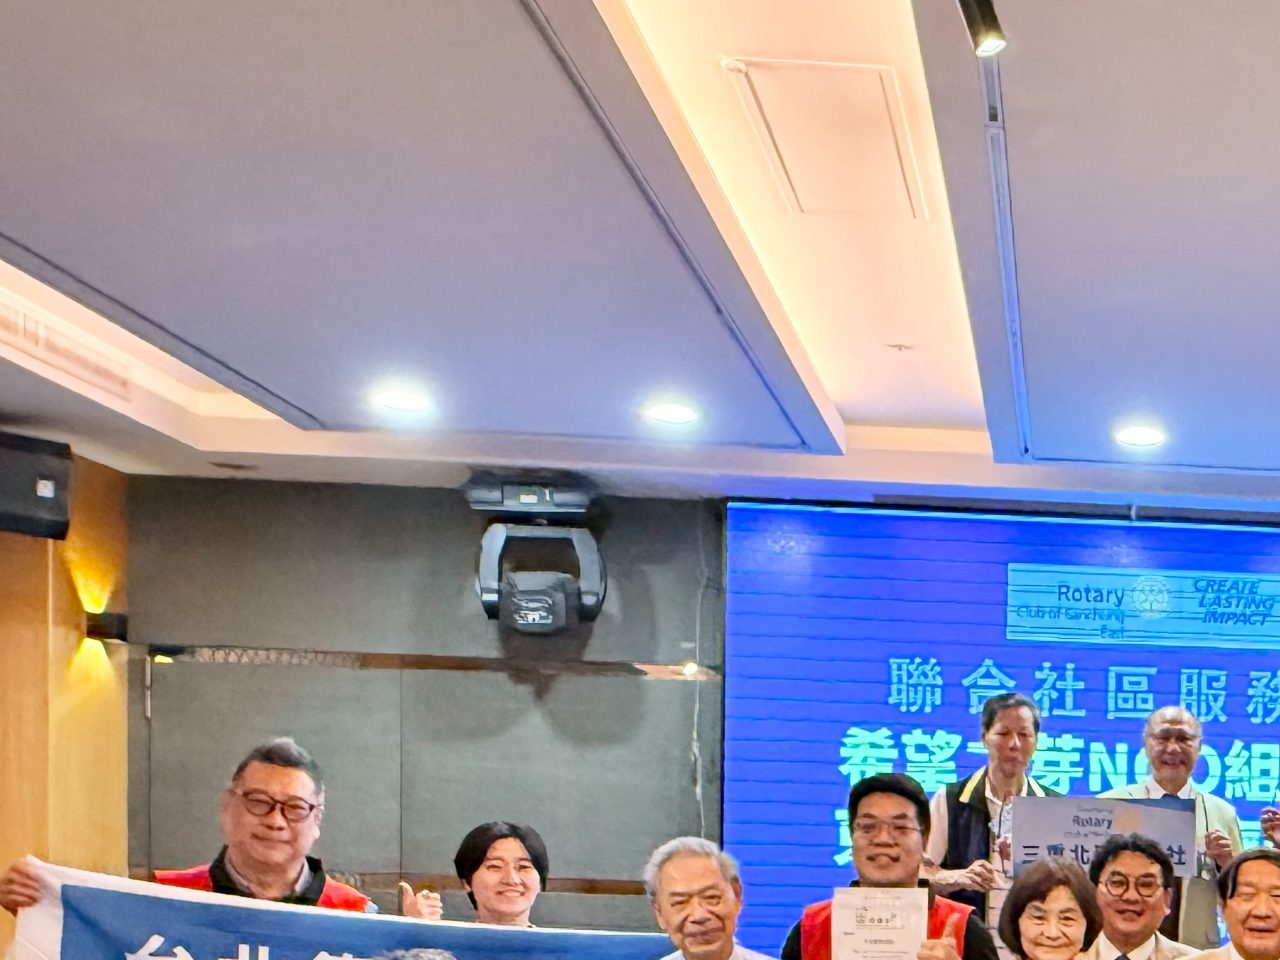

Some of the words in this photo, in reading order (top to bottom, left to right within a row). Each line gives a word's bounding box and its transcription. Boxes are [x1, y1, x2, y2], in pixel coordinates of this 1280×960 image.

[1194, 578, 1260, 594] CREATE
[1057, 585, 1125, 607] Rotary
[1199, 595, 1275, 610] LASTING
[1202, 611, 1270, 626] IMPACT
